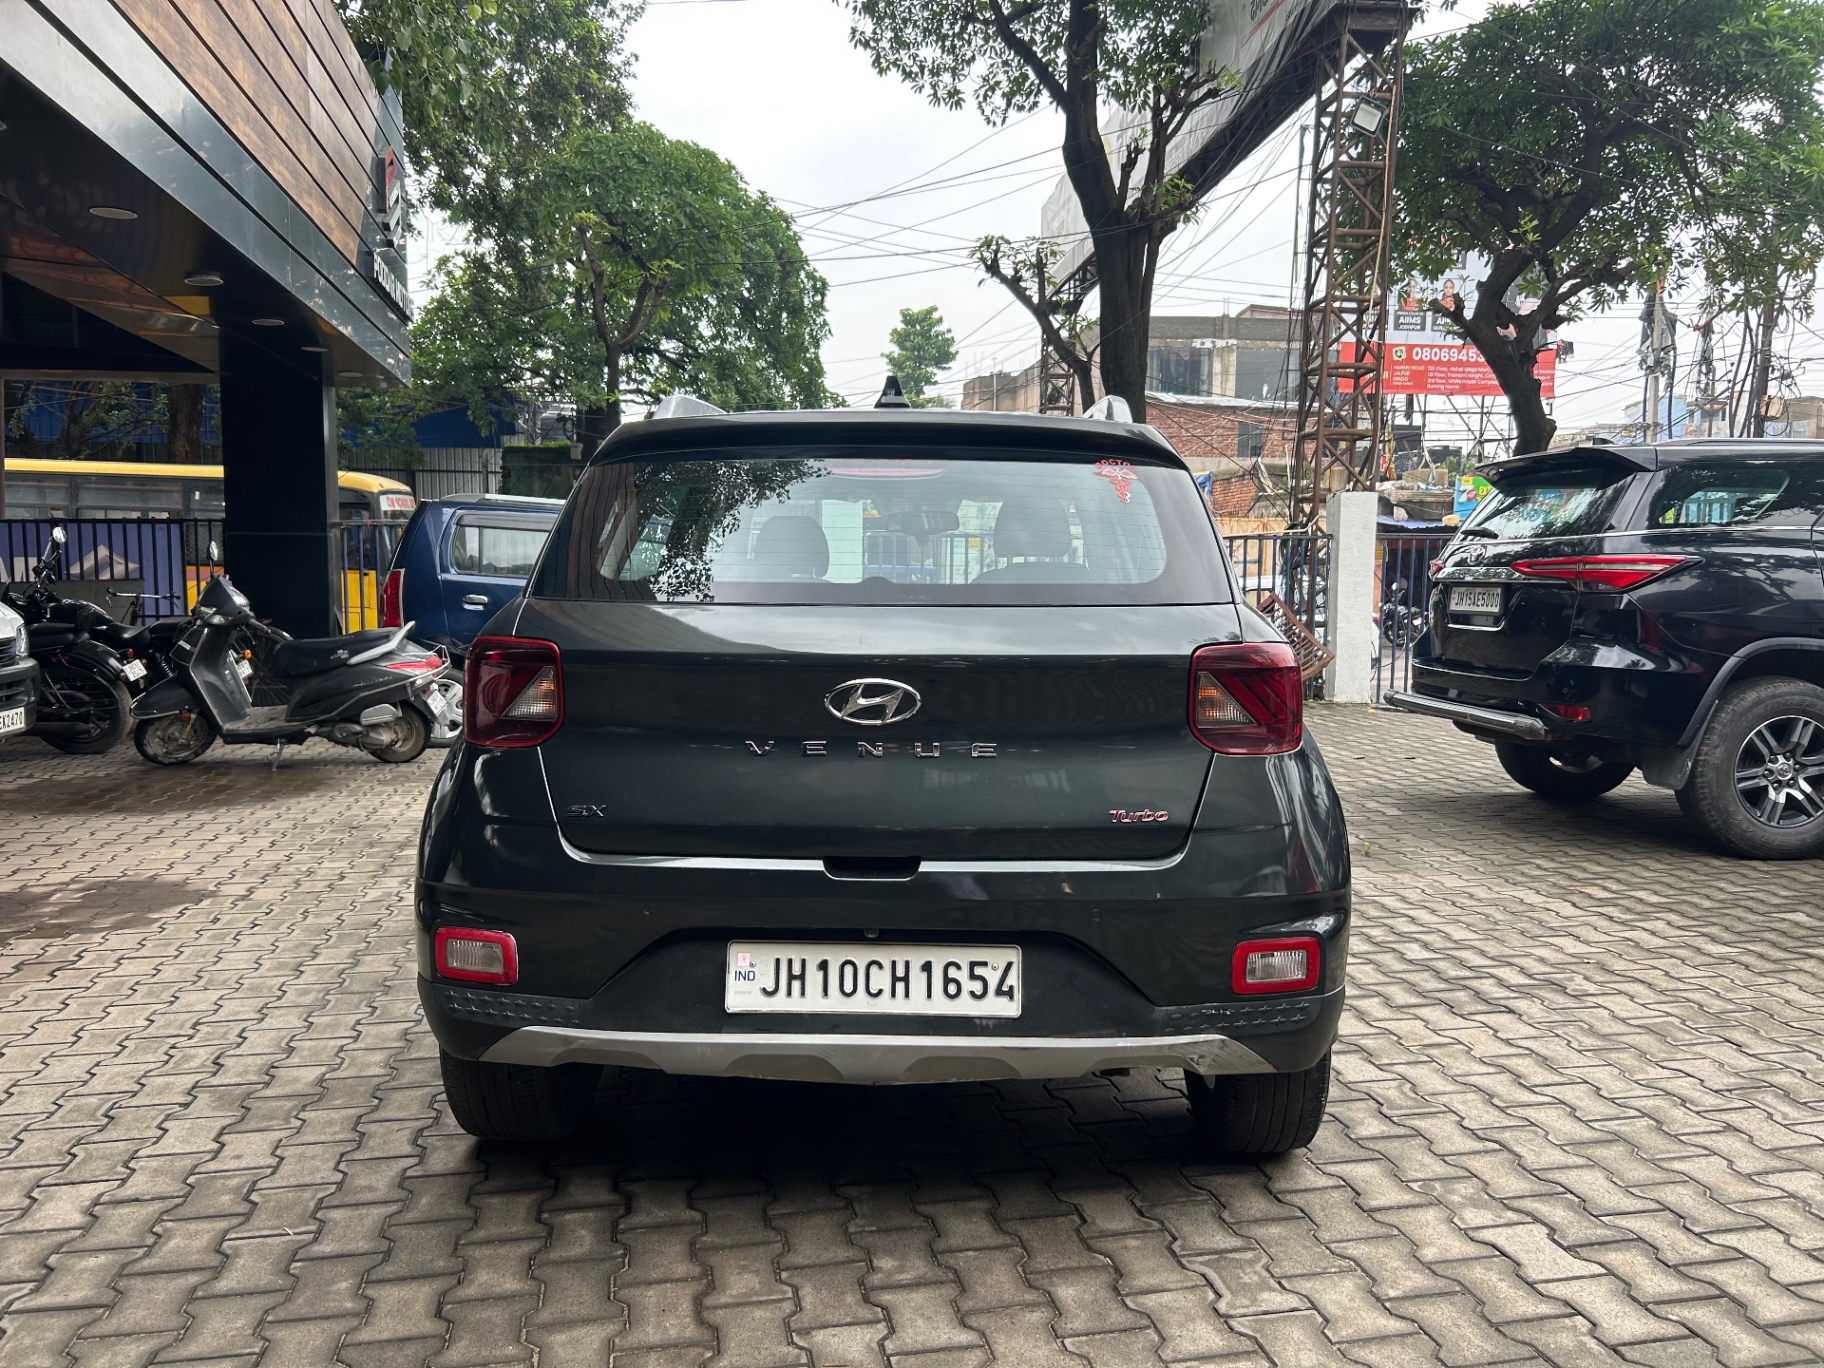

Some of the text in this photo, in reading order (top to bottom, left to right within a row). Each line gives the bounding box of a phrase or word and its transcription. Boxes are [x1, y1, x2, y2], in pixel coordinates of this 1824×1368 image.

[1398, 316, 1421, 324] AIIMS
[745, 740, 998, 758] VENUE
[566, 804, 607, 817] SX
[1109, 808, 1169, 823] Turbo
[734, 957, 1015, 1001] IND JH10CH1654
